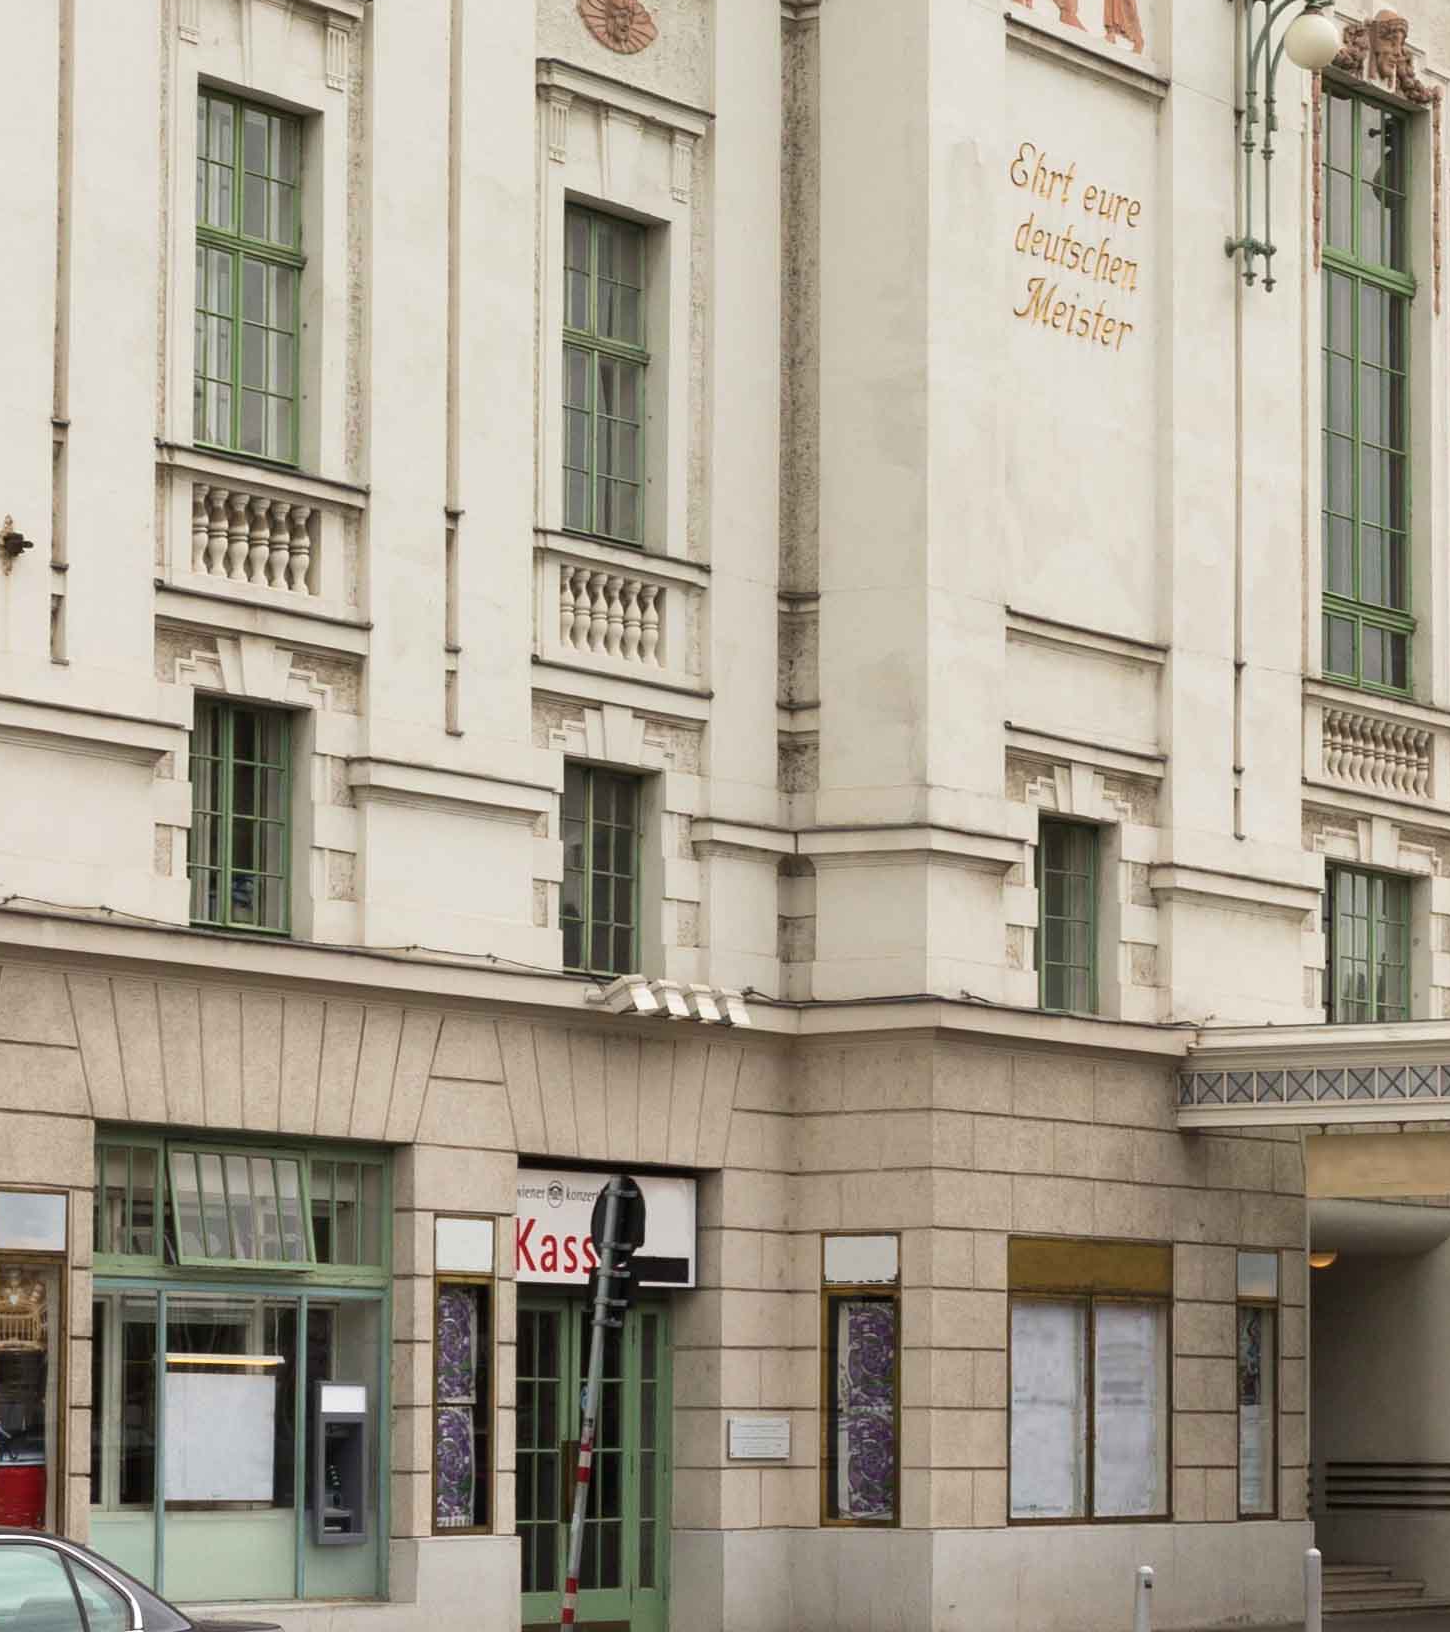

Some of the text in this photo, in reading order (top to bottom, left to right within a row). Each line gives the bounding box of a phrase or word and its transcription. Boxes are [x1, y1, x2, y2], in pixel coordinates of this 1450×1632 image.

[1010, 142, 1141, 228] Ehrt eure
[1014, 212, 1138, 291] deutschen
[1012, 277, 1133, 352] Meister
[566, 1186, 598, 1202] konzer
[516, 1216, 597, 1275] Kass
